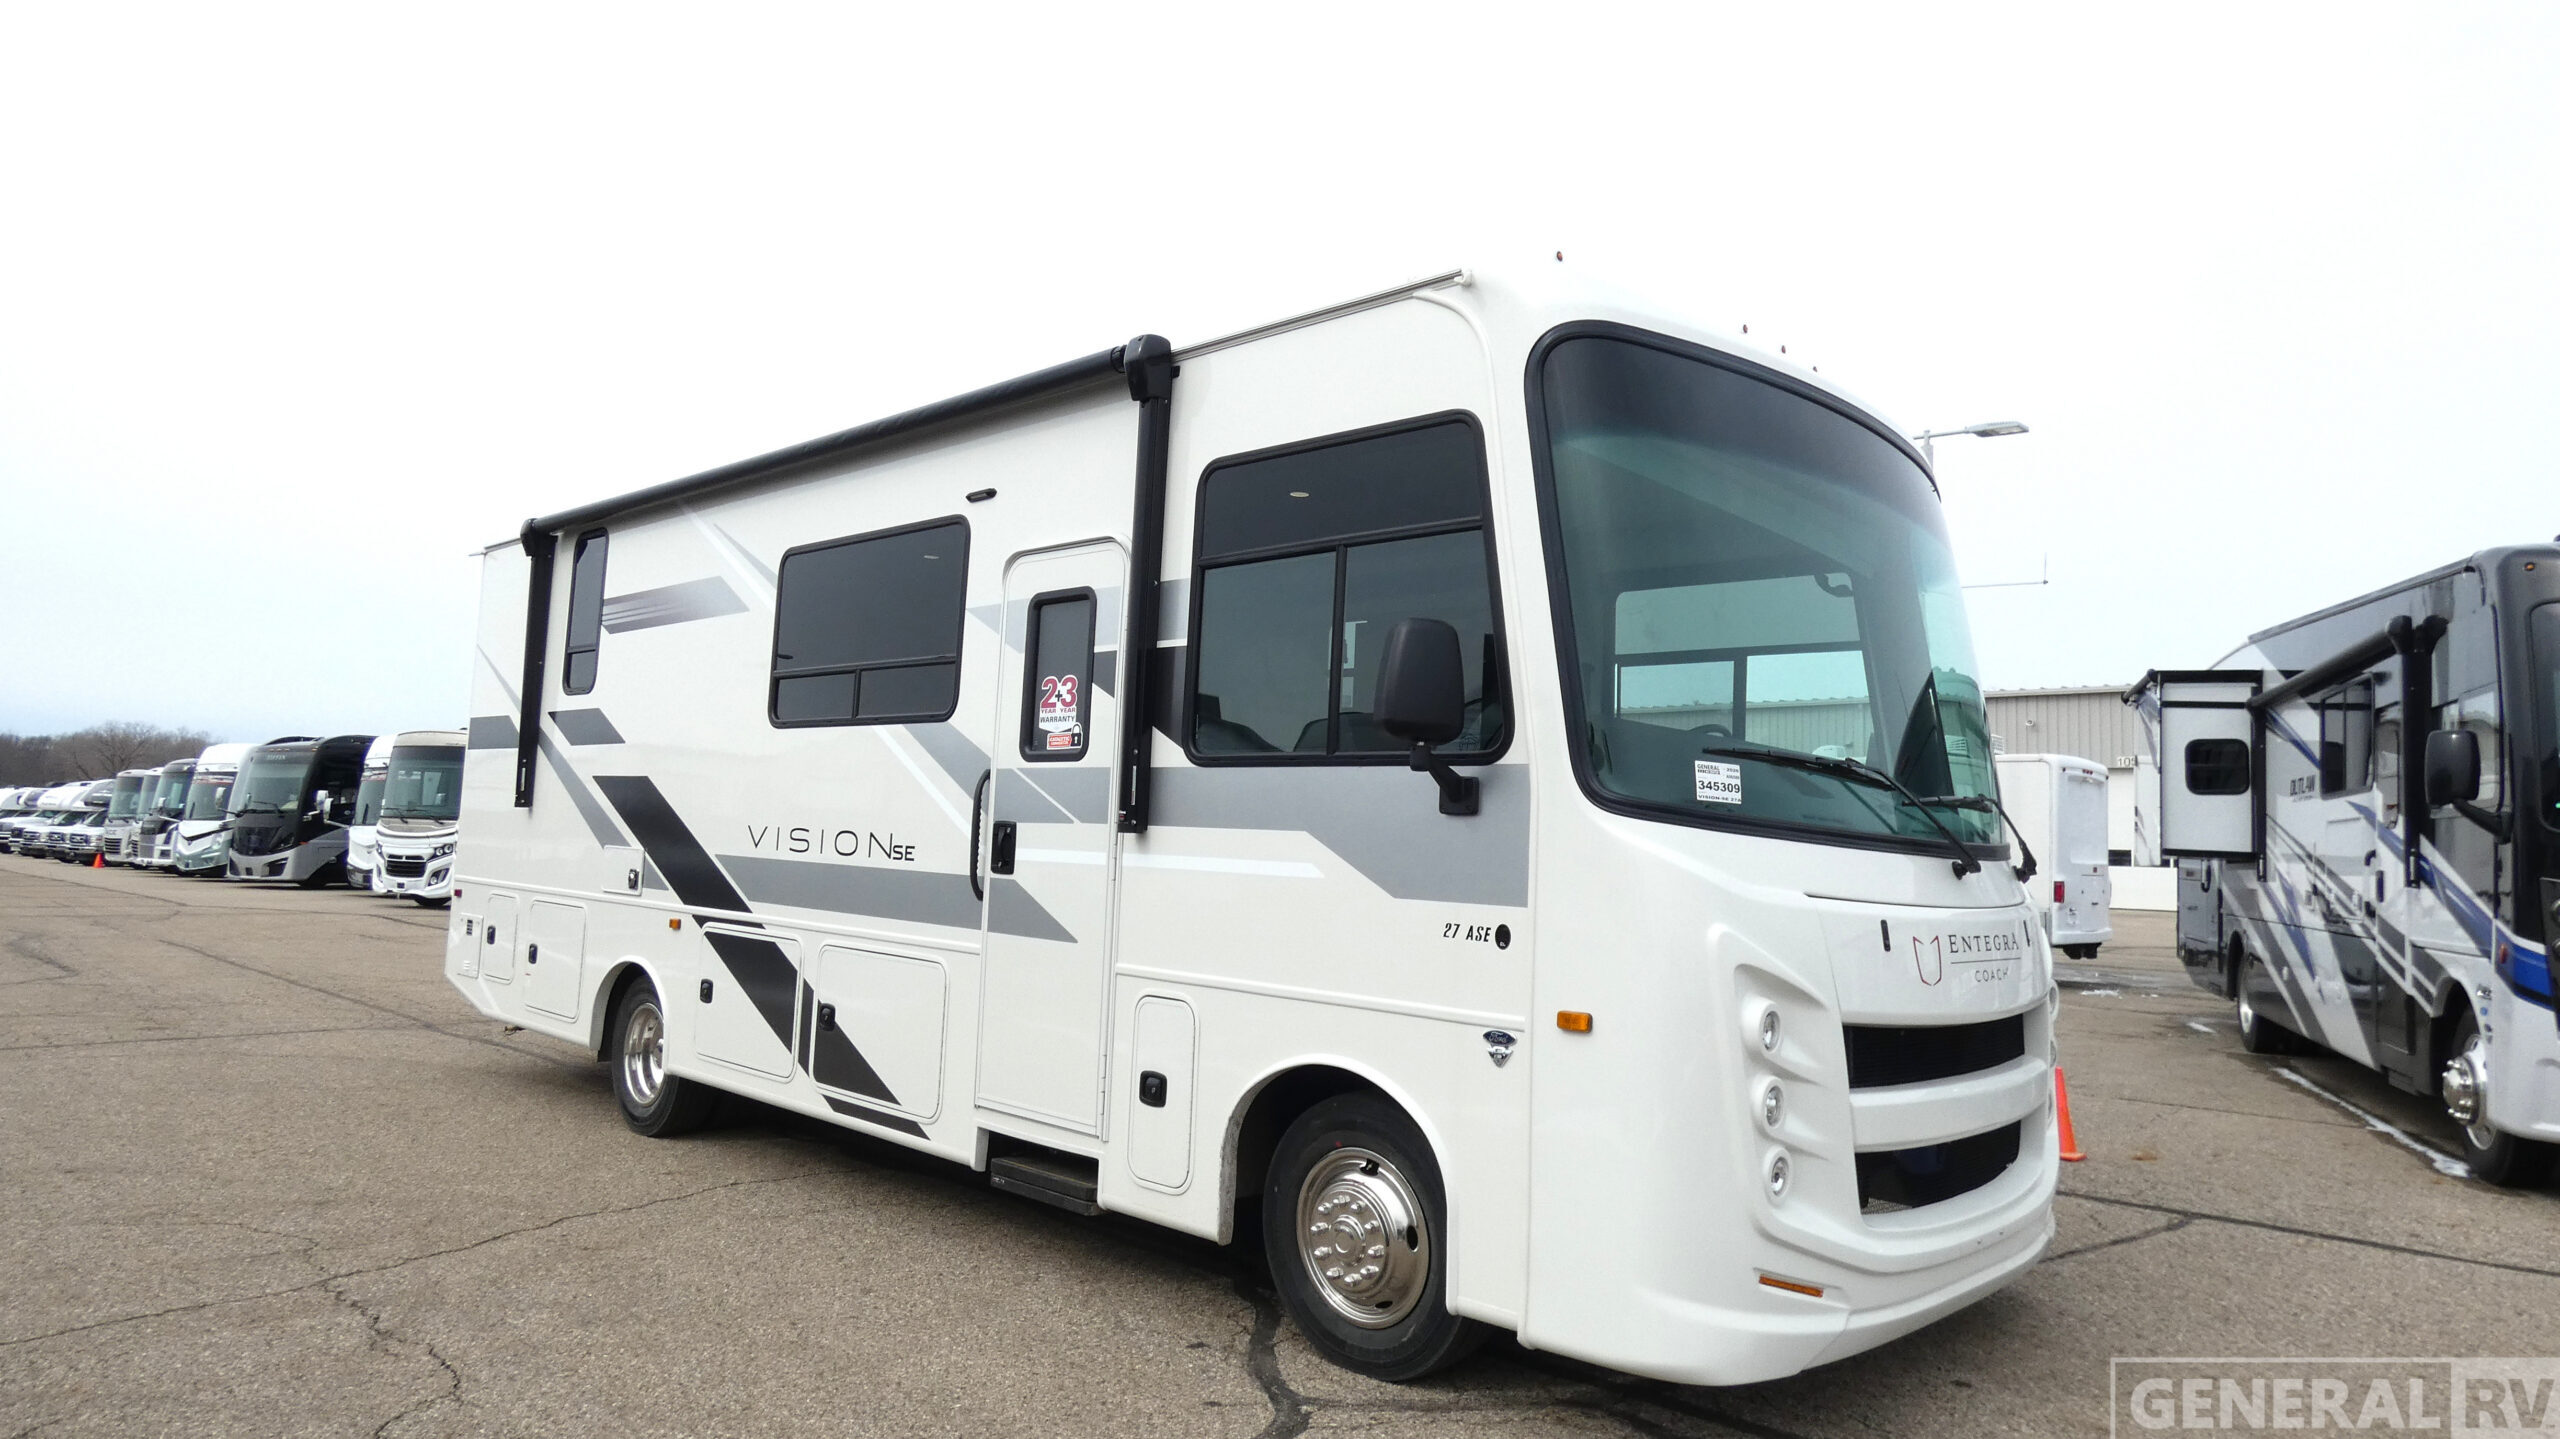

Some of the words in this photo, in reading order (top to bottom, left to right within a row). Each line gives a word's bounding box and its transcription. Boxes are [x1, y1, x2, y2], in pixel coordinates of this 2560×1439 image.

[1040, 715, 1075, 723] WARRANTY
[1698, 780, 1741, 794] 345309
[748, 825, 893, 859] VISION
[1443, 922, 1461, 939] 27
[1465, 925, 1492, 943] ASE
[1948, 932, 2020, 954] ENTEGRA
[1974, 967, 2009, 982] COACH
